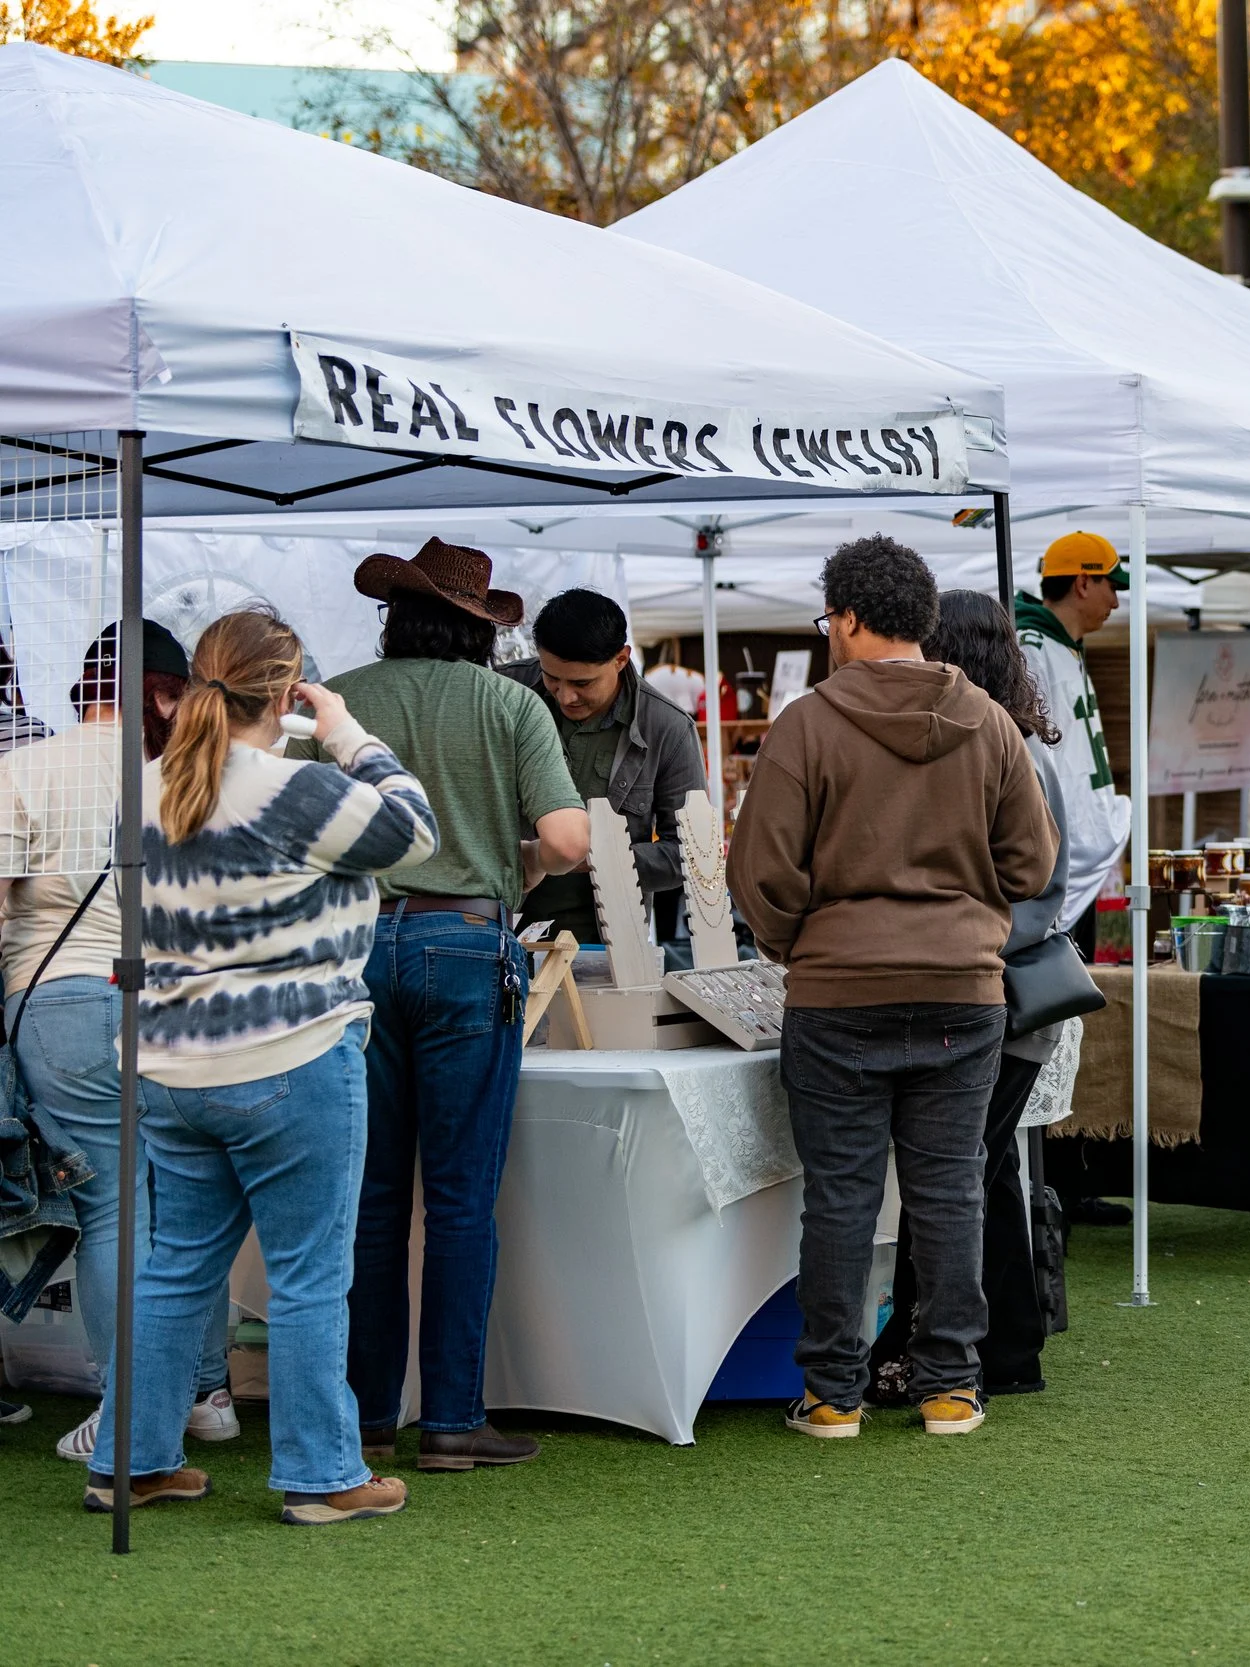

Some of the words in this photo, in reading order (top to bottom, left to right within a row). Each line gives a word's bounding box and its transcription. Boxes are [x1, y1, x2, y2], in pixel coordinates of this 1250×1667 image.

[317, 352, 479, 442] REAL
[494, 395, 734, 473] FLOWERS
[752, 417, 940, 480] JEWELRY
